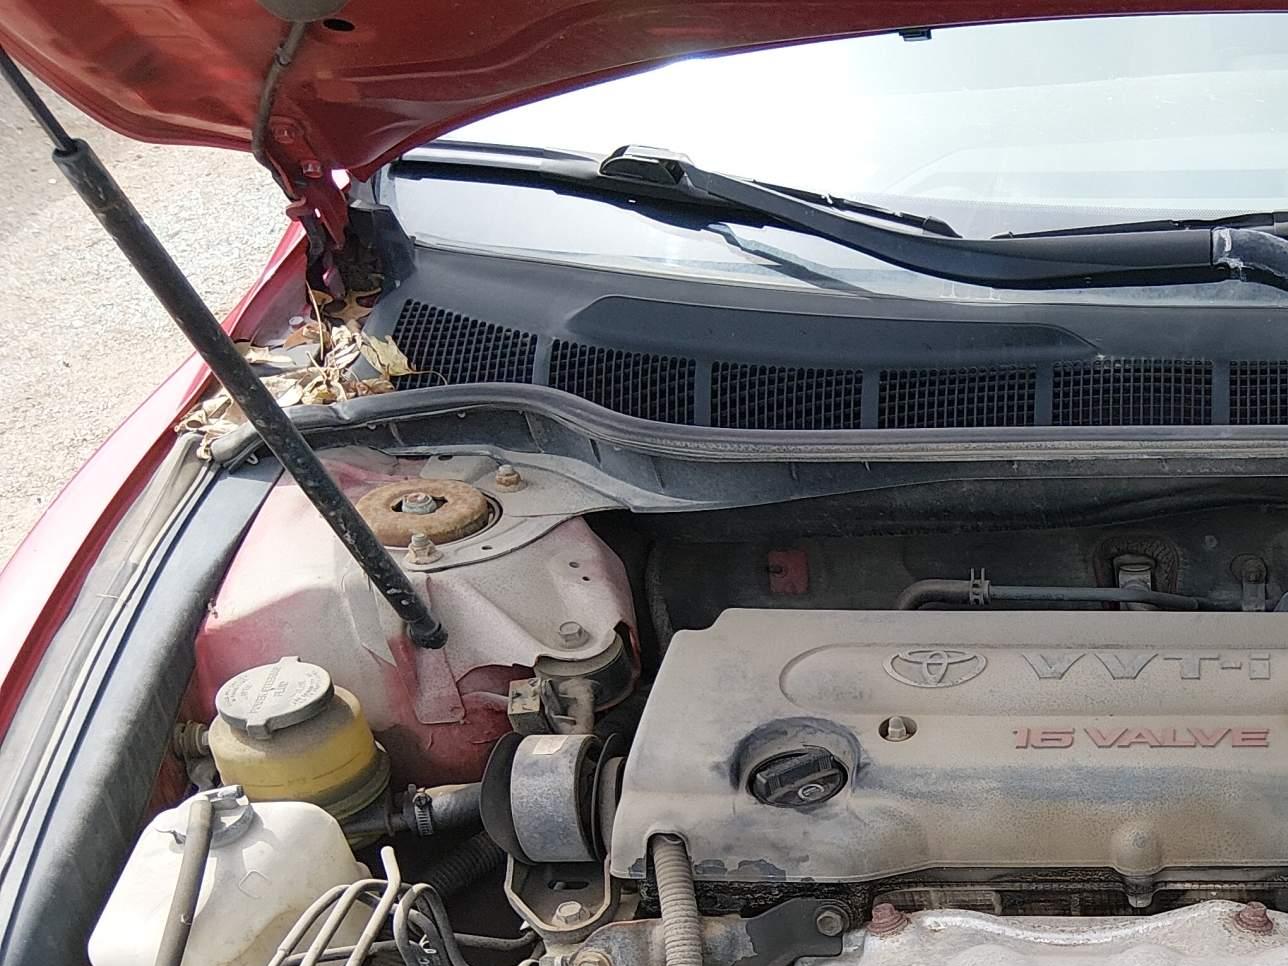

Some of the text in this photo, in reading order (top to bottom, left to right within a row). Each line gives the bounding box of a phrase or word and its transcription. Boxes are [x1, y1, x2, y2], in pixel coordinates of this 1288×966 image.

[1020, 652, 1272, 681] VVT-i
[1013, 727, 1271, 749] 16 VALVE
